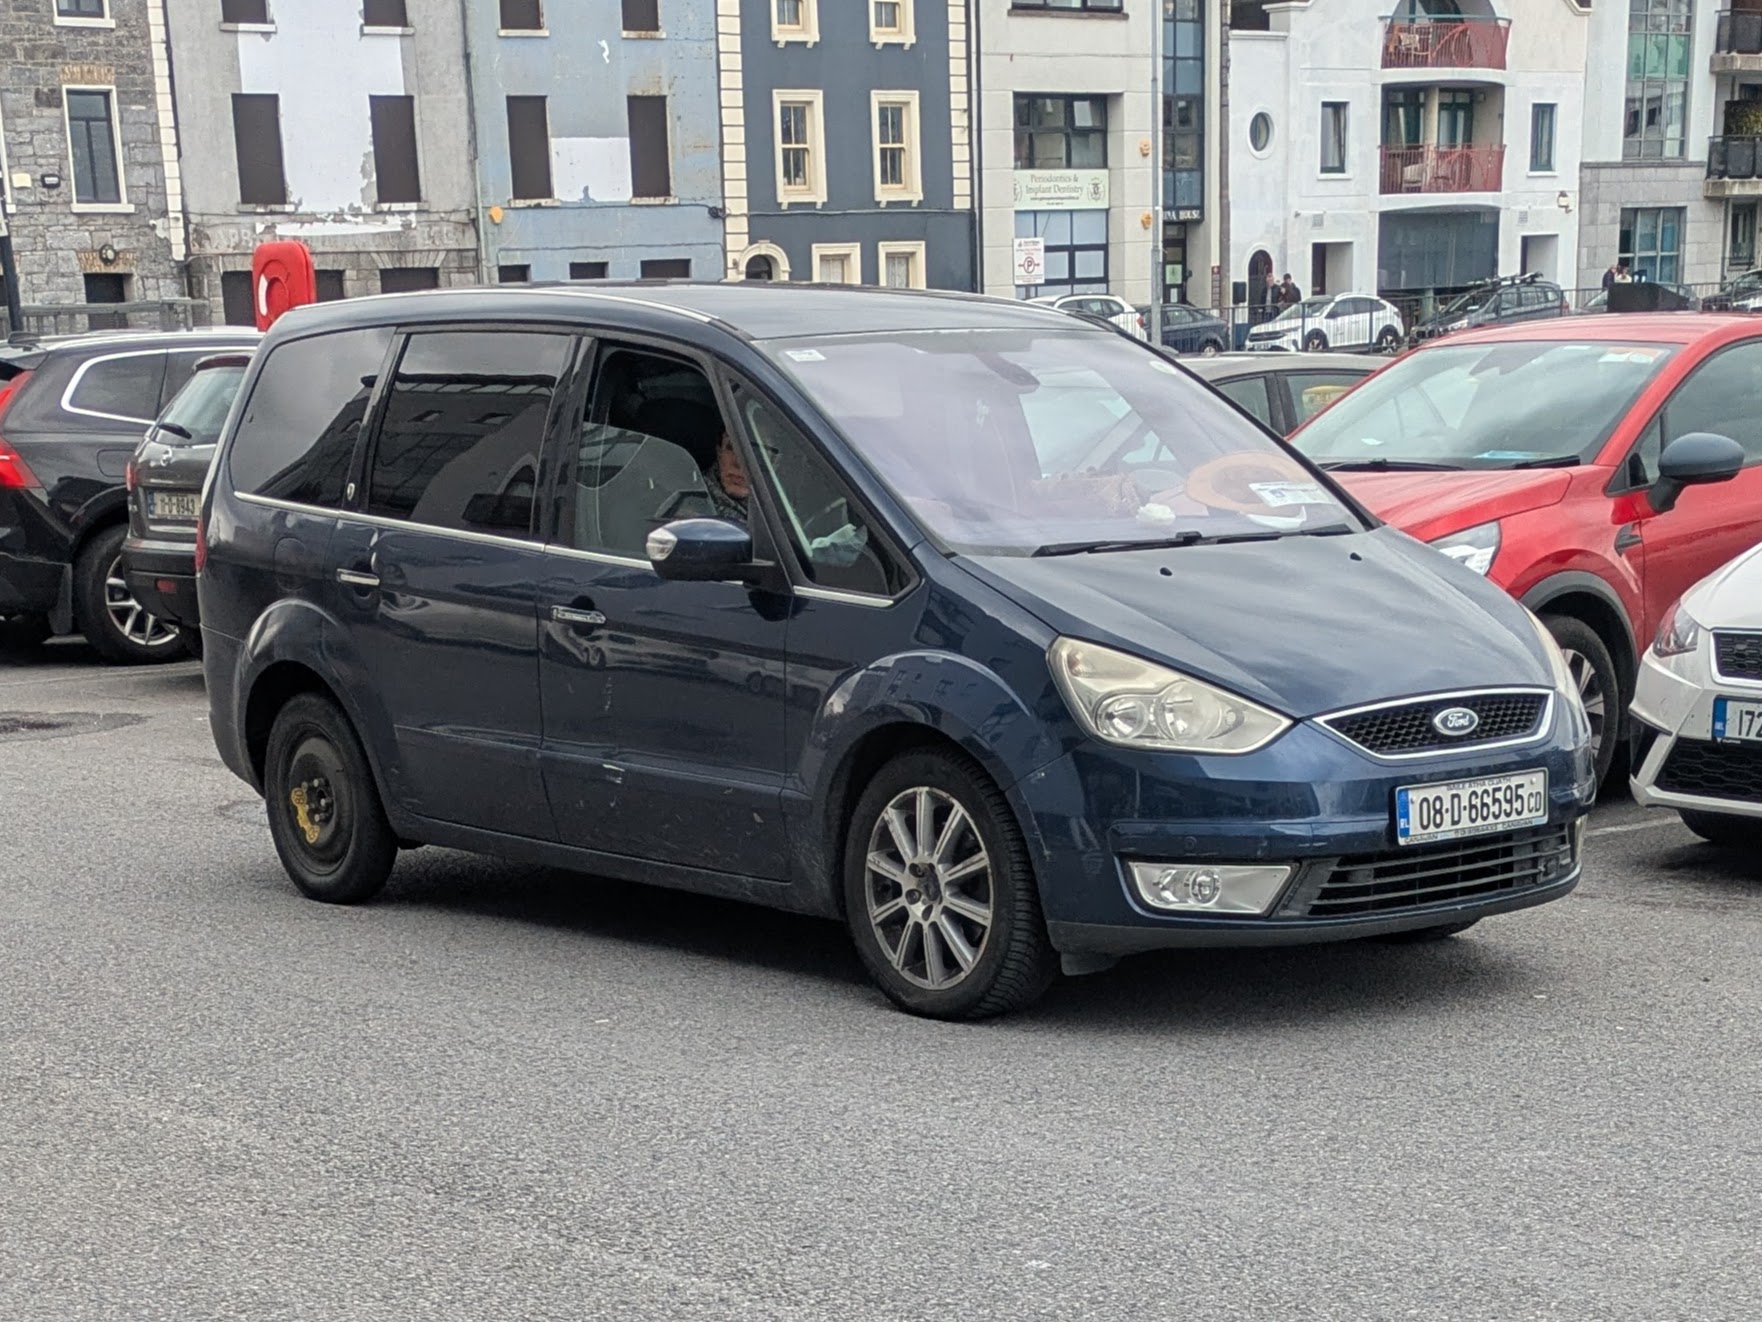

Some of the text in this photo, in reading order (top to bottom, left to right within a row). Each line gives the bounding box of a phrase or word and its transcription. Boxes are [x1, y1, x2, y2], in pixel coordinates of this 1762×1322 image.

[1030, 174, 1071, 183] Periodontics
[1025, 184, 1083, 197] Implant Dentistry
[1447, 712, 1470, 728] Ford
[1527, 791, 1542, 813] CD
